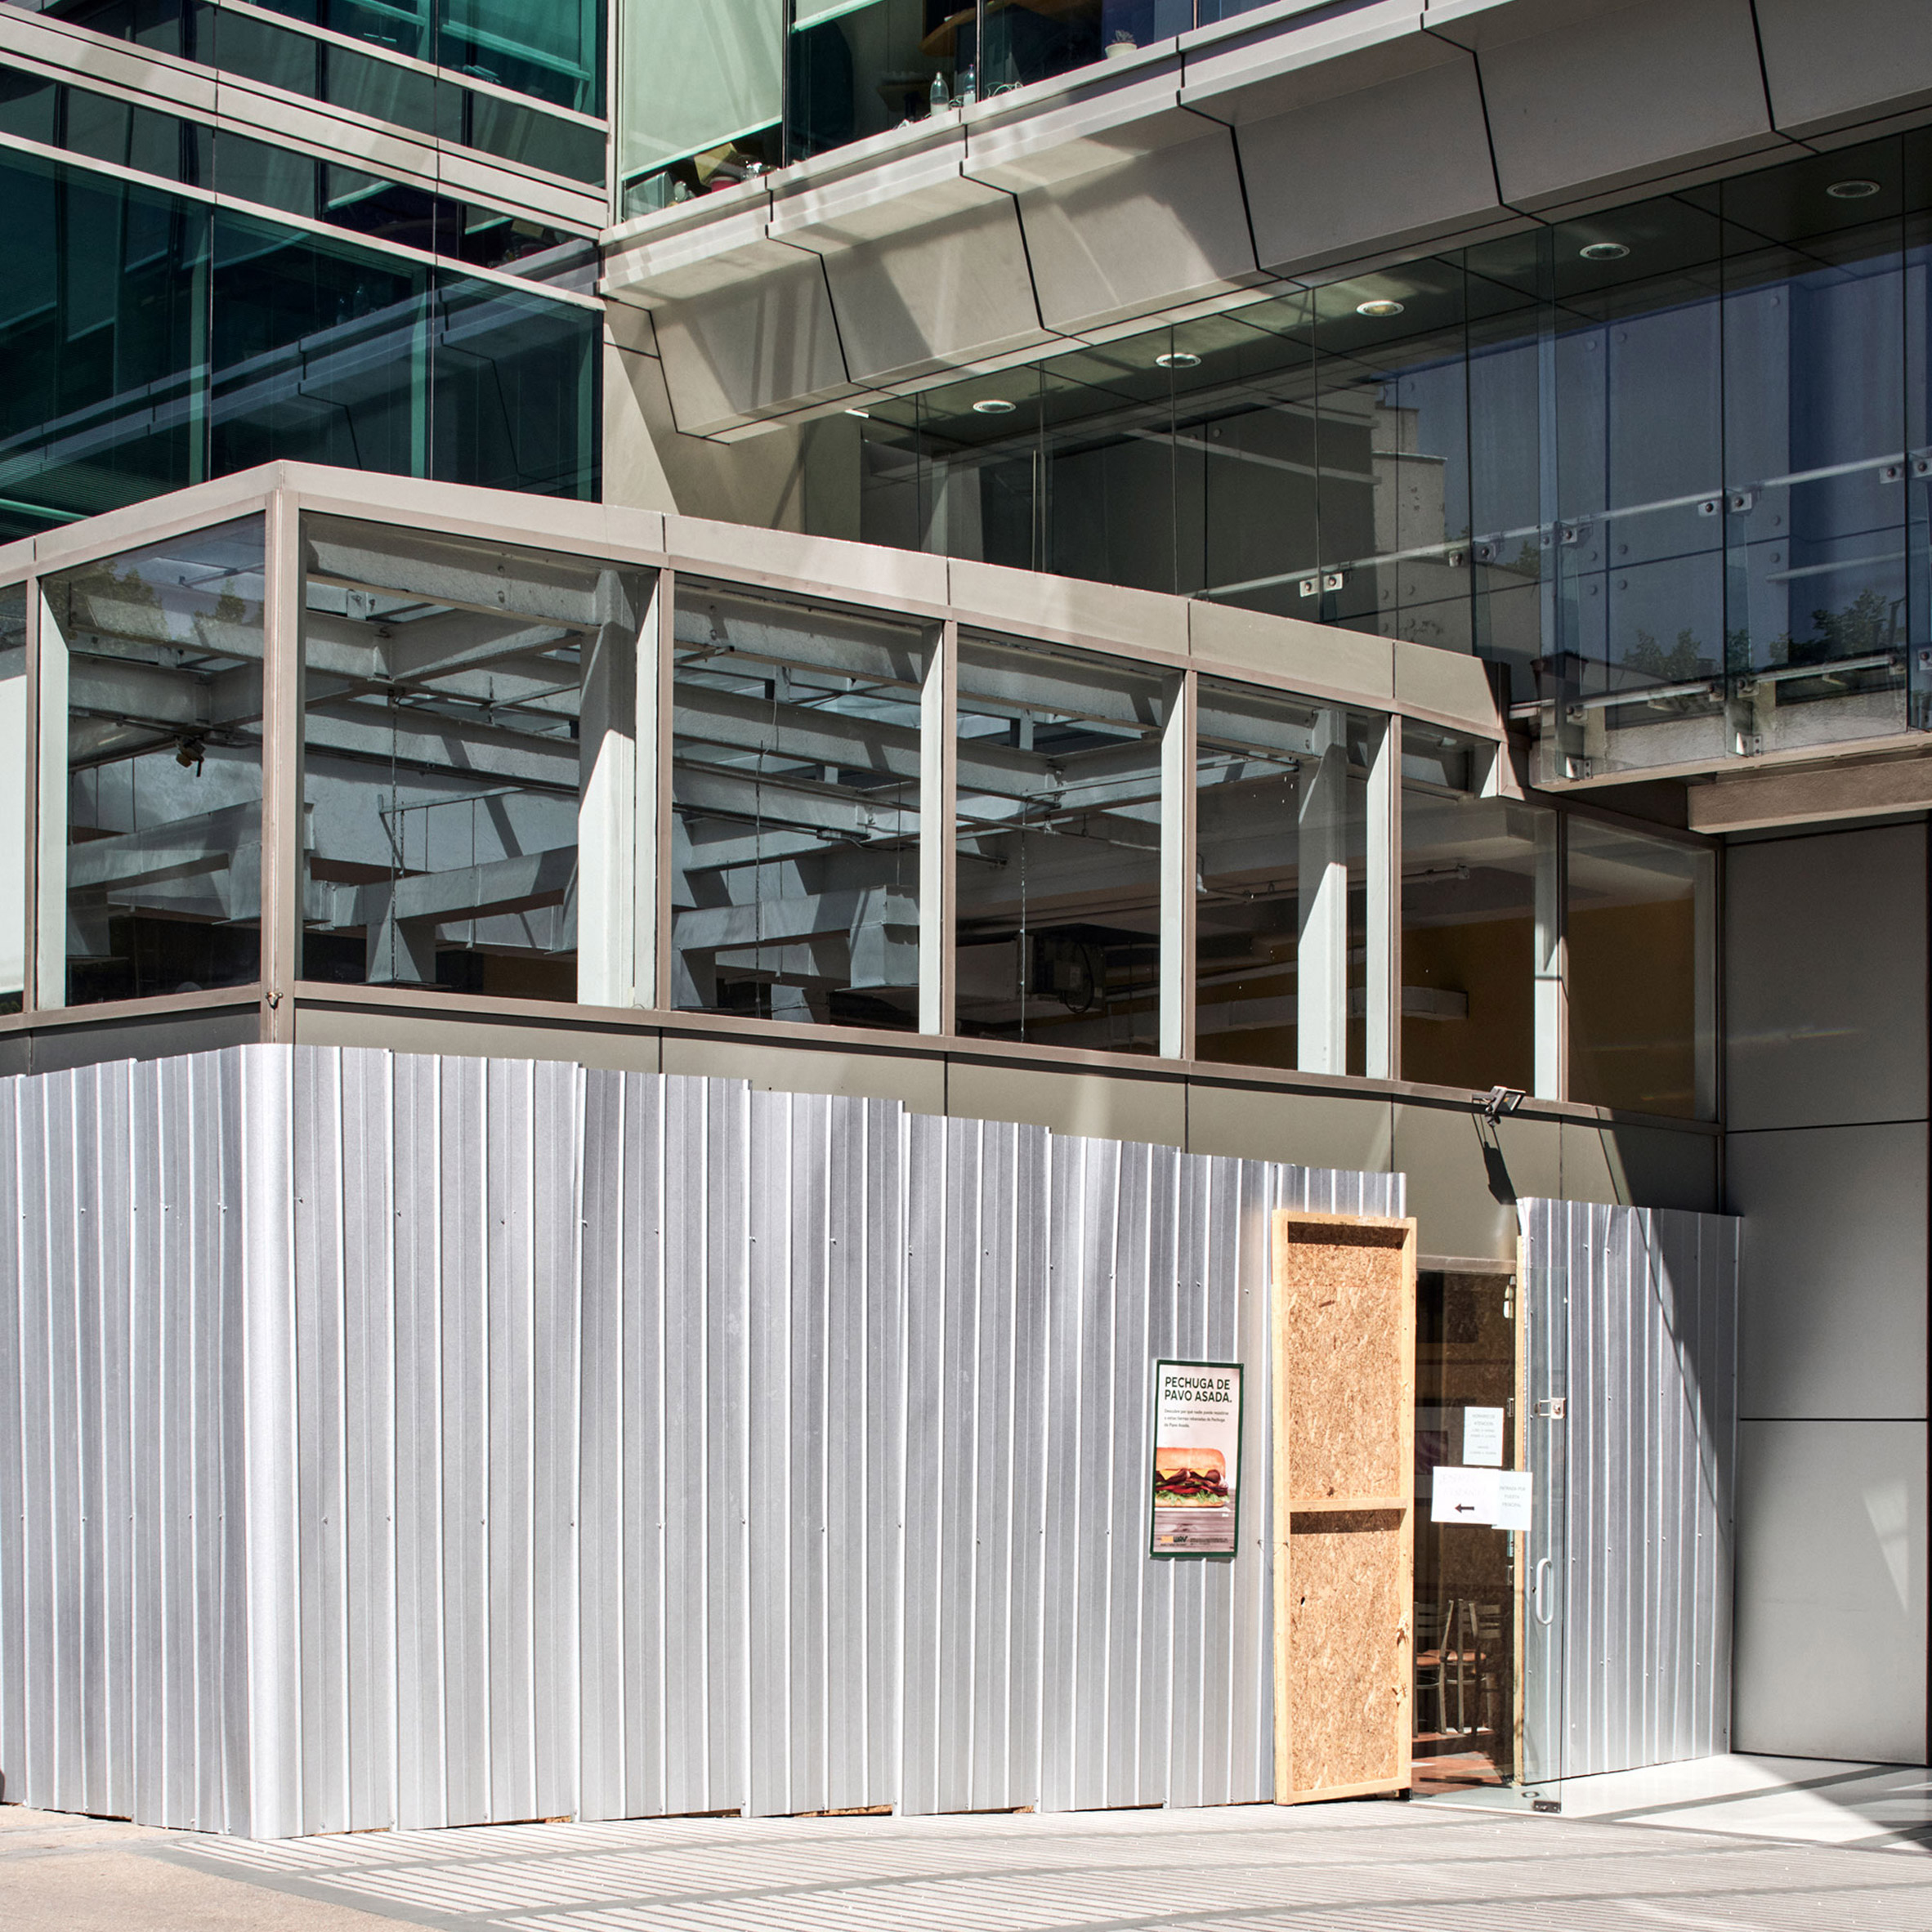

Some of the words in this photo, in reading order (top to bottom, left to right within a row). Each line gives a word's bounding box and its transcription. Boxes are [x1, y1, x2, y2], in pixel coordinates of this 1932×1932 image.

[1165, 1376, 1214, 1389] PECHUGA
[1217, 1379, 1231, 1390] DE
[1164, 1389, 1192, 1402] PAVO
[1195, 1391, 1232, 1403] ASADA.
